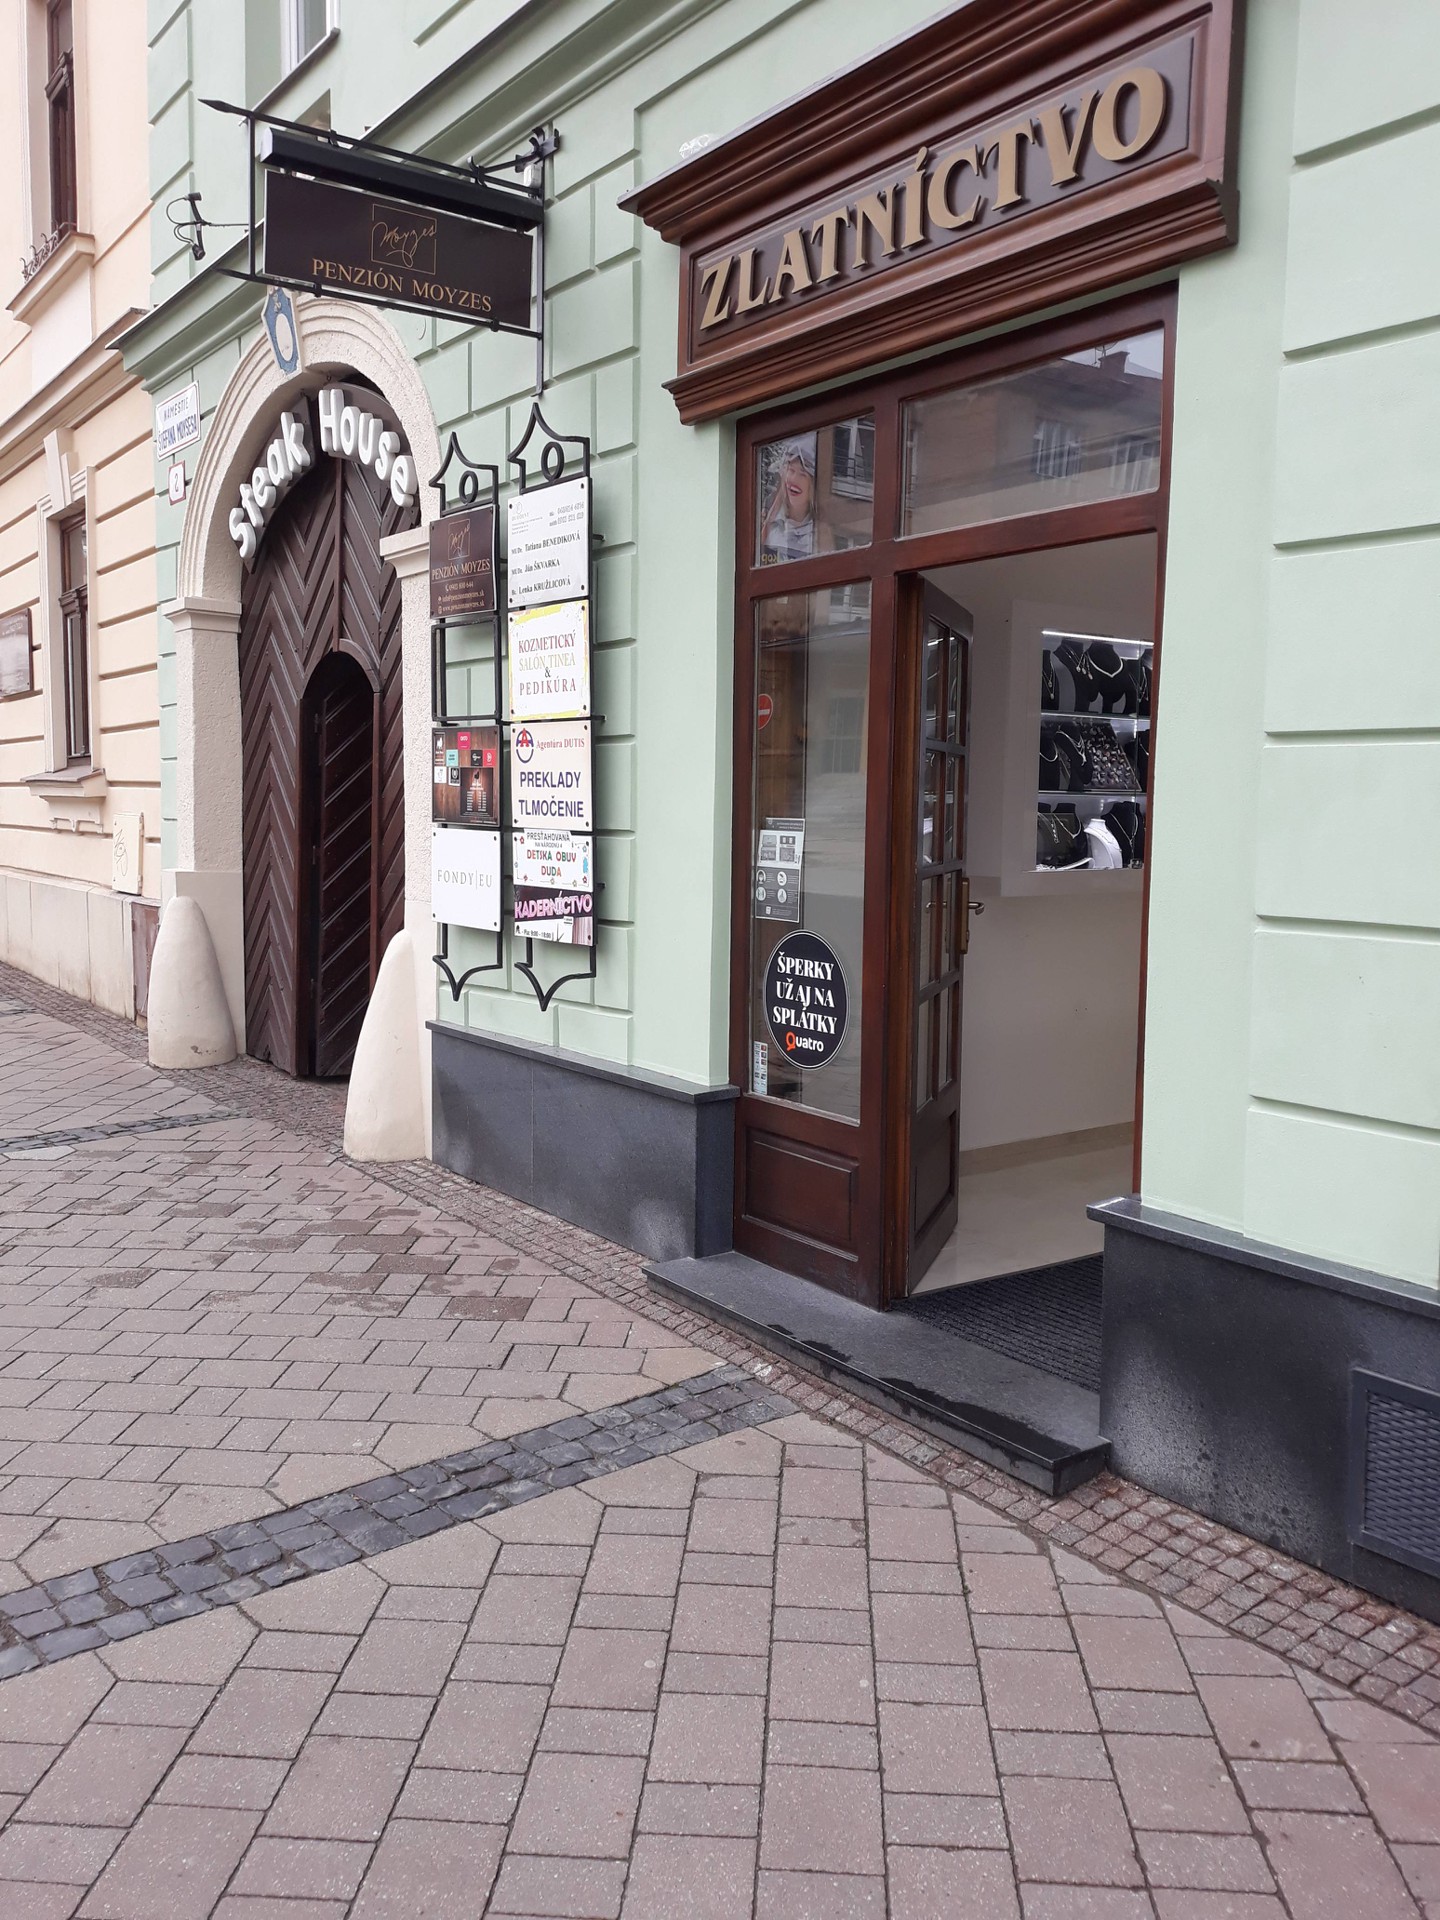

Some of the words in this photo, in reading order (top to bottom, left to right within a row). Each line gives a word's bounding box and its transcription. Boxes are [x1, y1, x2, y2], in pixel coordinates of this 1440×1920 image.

[701, 66, 1167, 330] ZLATNÍCTVO
[312, 257, 403, 293] PENZIÓN
[411, 279, 492, 313] MOYZES
[174, 473, 179, 492] 2
[229, 411, 310, 559] Steak
[318, 388, 418, 507] House
[525, 541, 541, 552] Tatiana
[542, 530, 581, 548] BENEDIKOVÁ
[431, 561, 459, 580] PENZIÓN
[461, 558, 491, 575] MOYZES
[525, 563, 533, 573] Ján
[533, 558, 560, 571] ŠKVARKA
[519, 585, 532, 594] Lenka
[533, 575, 571, 592] KRUŽLICOVÁ
[518, 629, 576, 653] KOZMETICKÝ
[519, 653, 545, 671] SALÓN
[548, 652, 576, 668] TINEA
[545, 667, 551, 678] &
[520, 676, 576, 696] PEDIKÚRA
[536, 738, 562, 751] Agentúra
[564, 738, 585, 748] DUTIS
[520, 771, 581, 788] PREKLADY
[518, 795, 584, 818] TLMOČENIE
[527, 849, 552, 861] DETSKA
[556, 850, 576, 862] OBUV
[541, 866, 562, 877] DUDA
[514, 891, 592, 919] KADERNÍCTVO
[777, 951, 834, 981] ŠPERKY
[776, 978, 794, 1000] UŽ
[795, 984, 811, 1007] AJ
[814, 987, 835, 1008] NA
[773, 1006, 837, 1035] SPLÁTKY
[785, 1031, 824, 1052] Quatro
